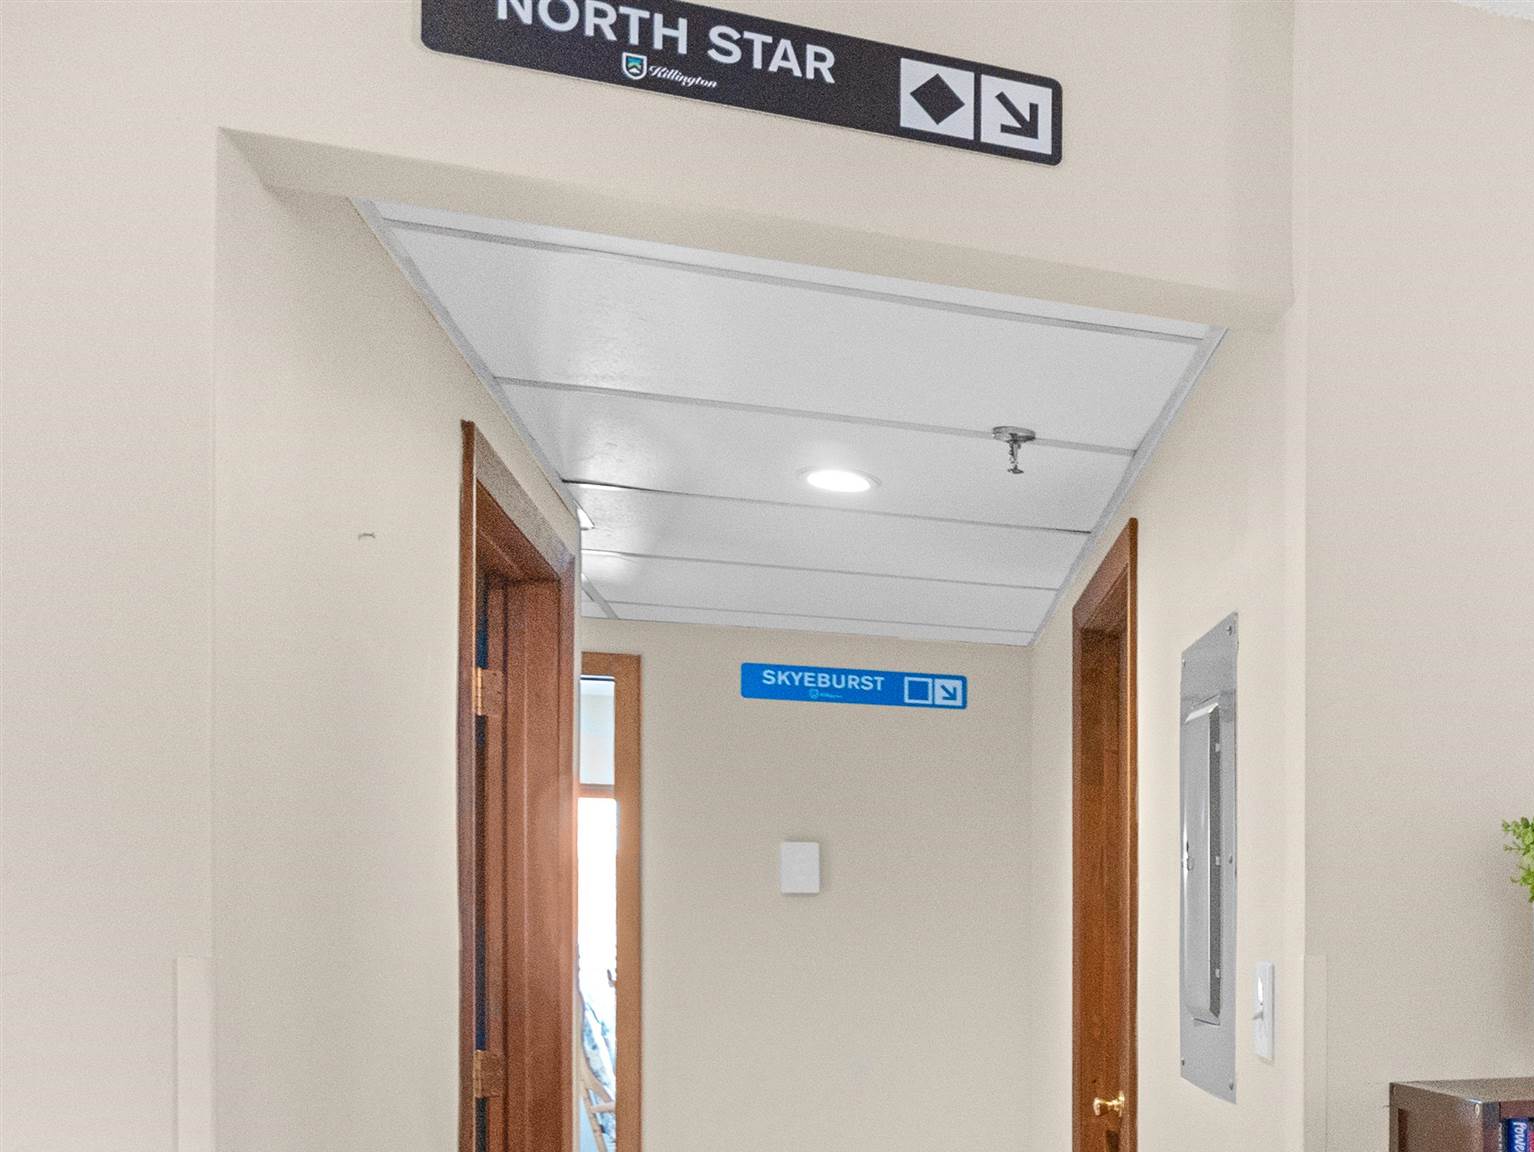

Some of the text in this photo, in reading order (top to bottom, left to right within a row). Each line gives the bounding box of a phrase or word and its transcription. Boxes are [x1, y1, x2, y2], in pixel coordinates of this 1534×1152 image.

[496, 0, 836, 84] NORTH STAR
[648, 65, 718, 88] Killington
[762, 669, 885, 691] SKYEBURST
